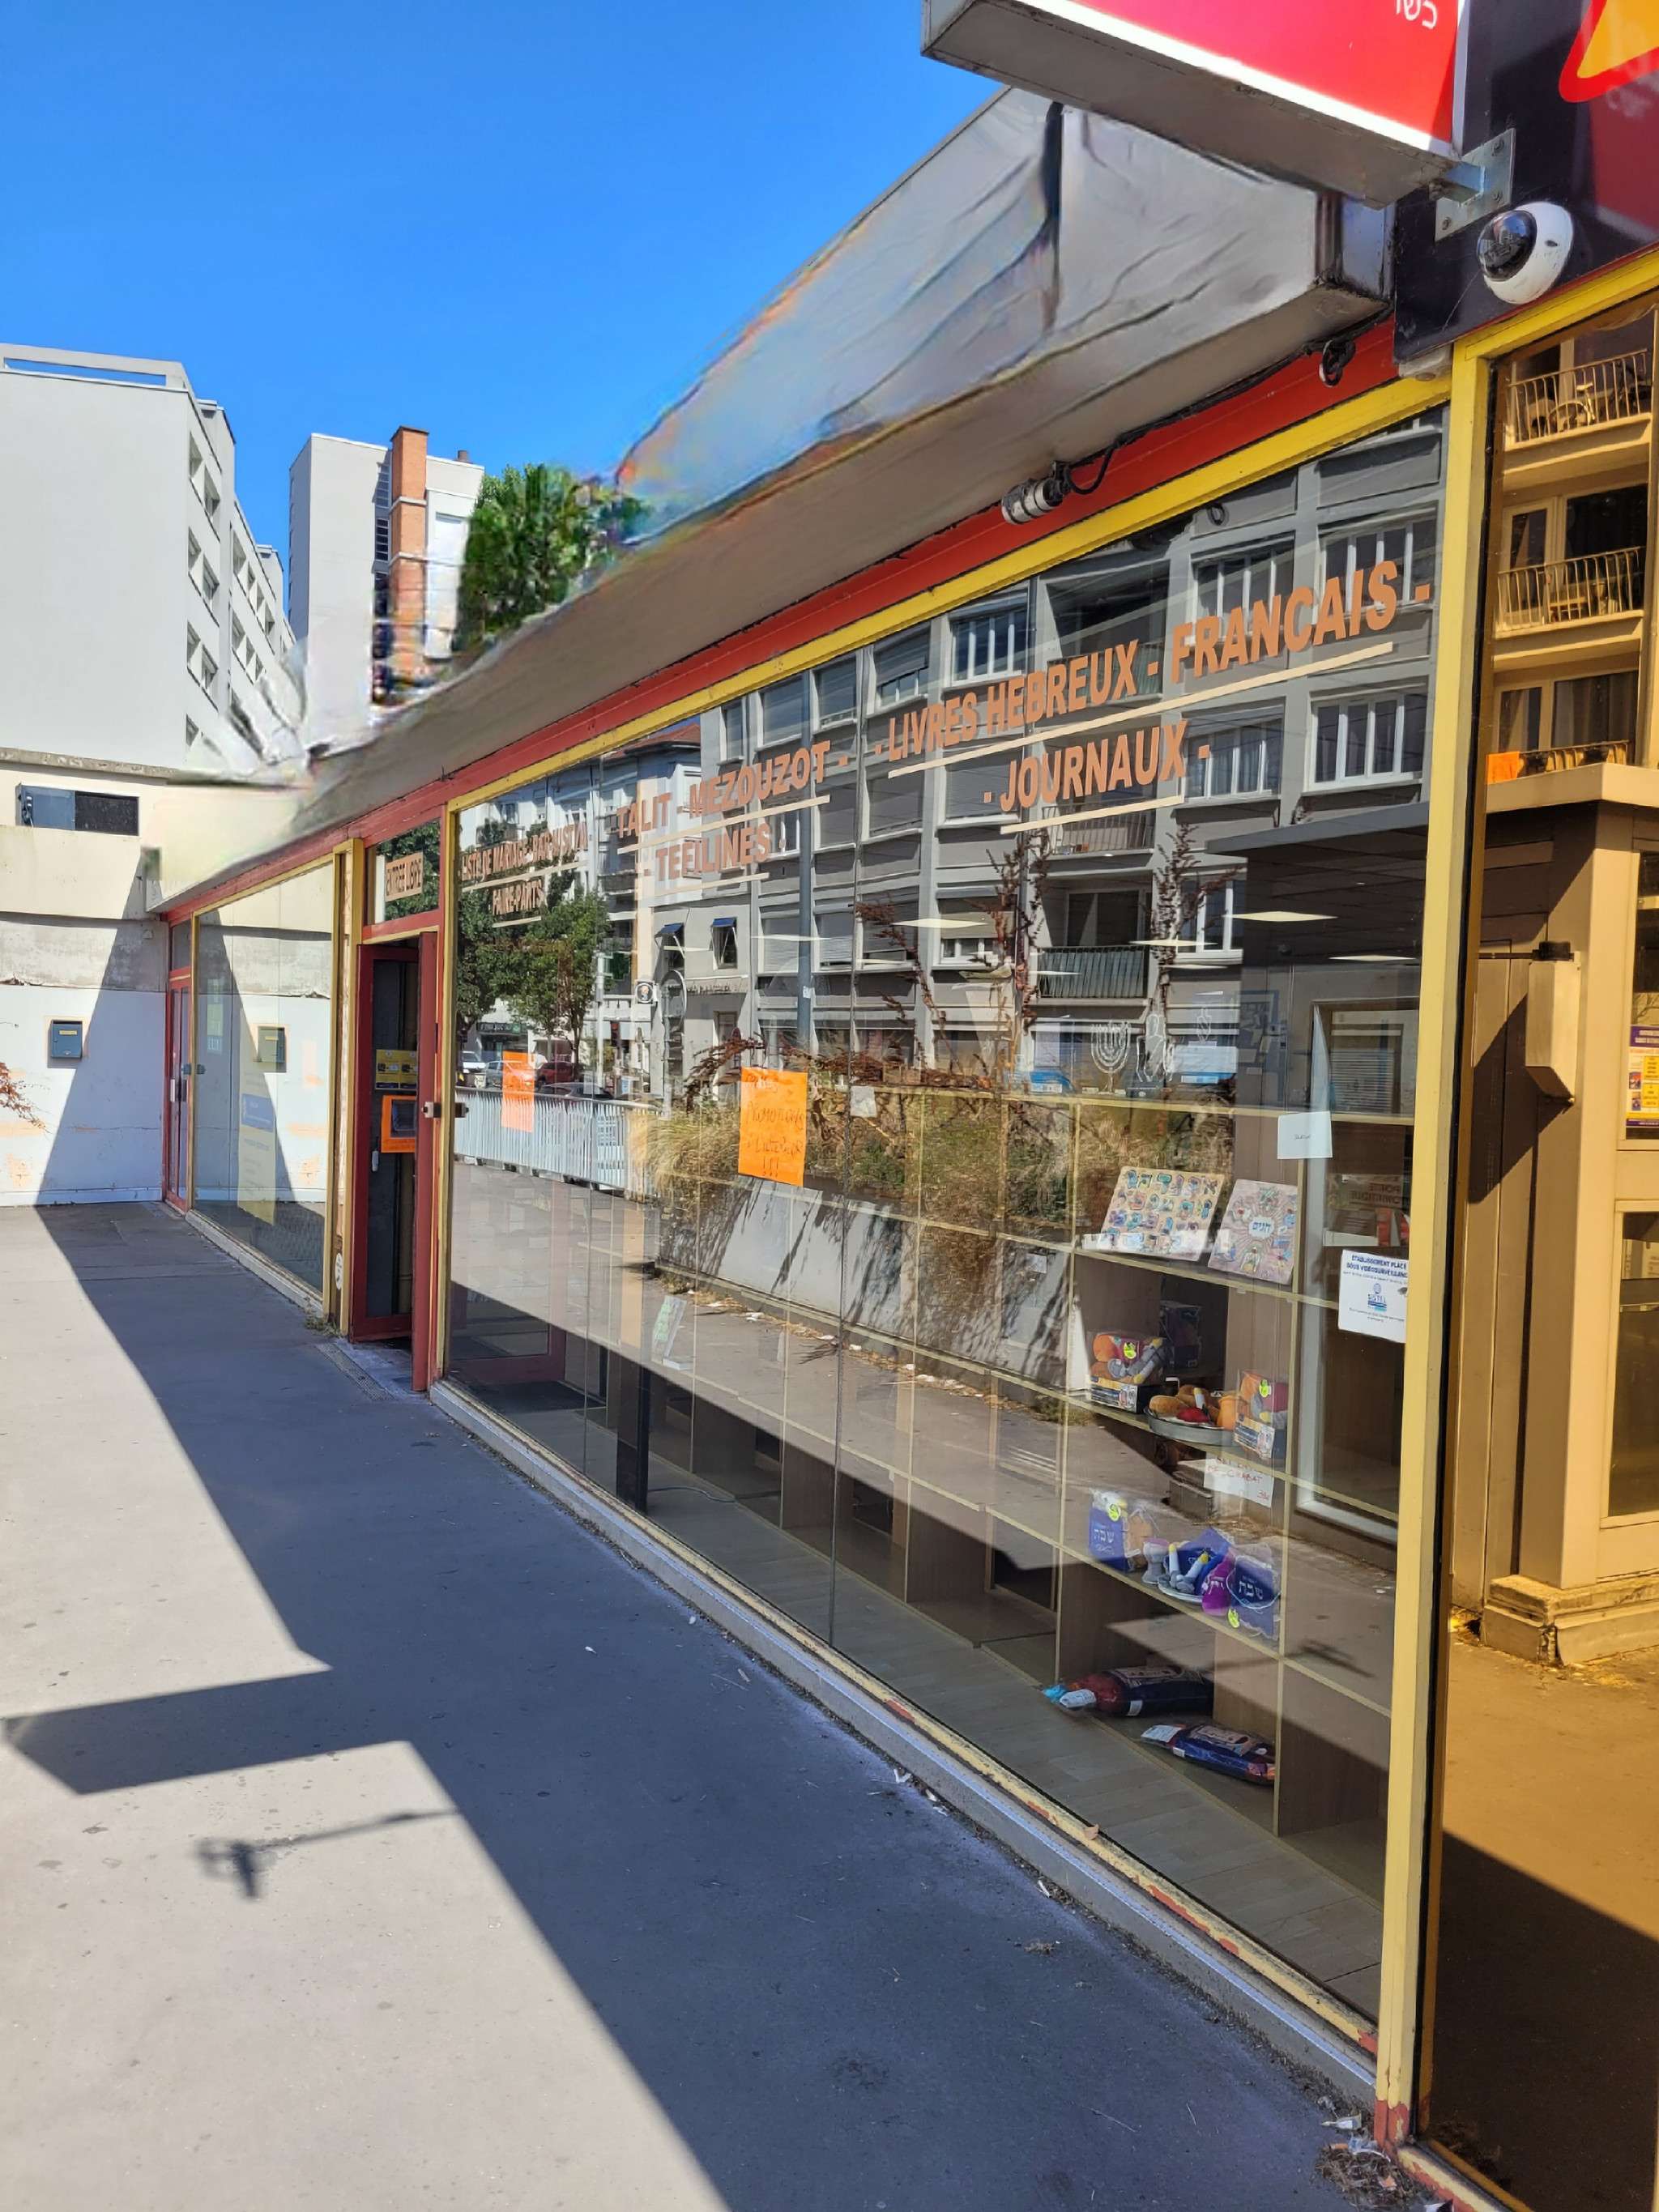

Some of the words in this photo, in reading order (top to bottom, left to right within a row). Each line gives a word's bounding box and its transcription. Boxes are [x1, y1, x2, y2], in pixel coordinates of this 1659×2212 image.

[889, 693, 978, 762] LIVRES
[987, 639, 1139, 736] HEBREUX
[1171, 560, 1398, 684] FRANCAIS
[616, 792, 672, 838] TALIT
[689, 740, 831, 819] MEZOUZOT
[1000, 718, 1189, 812] JOURNAUX
